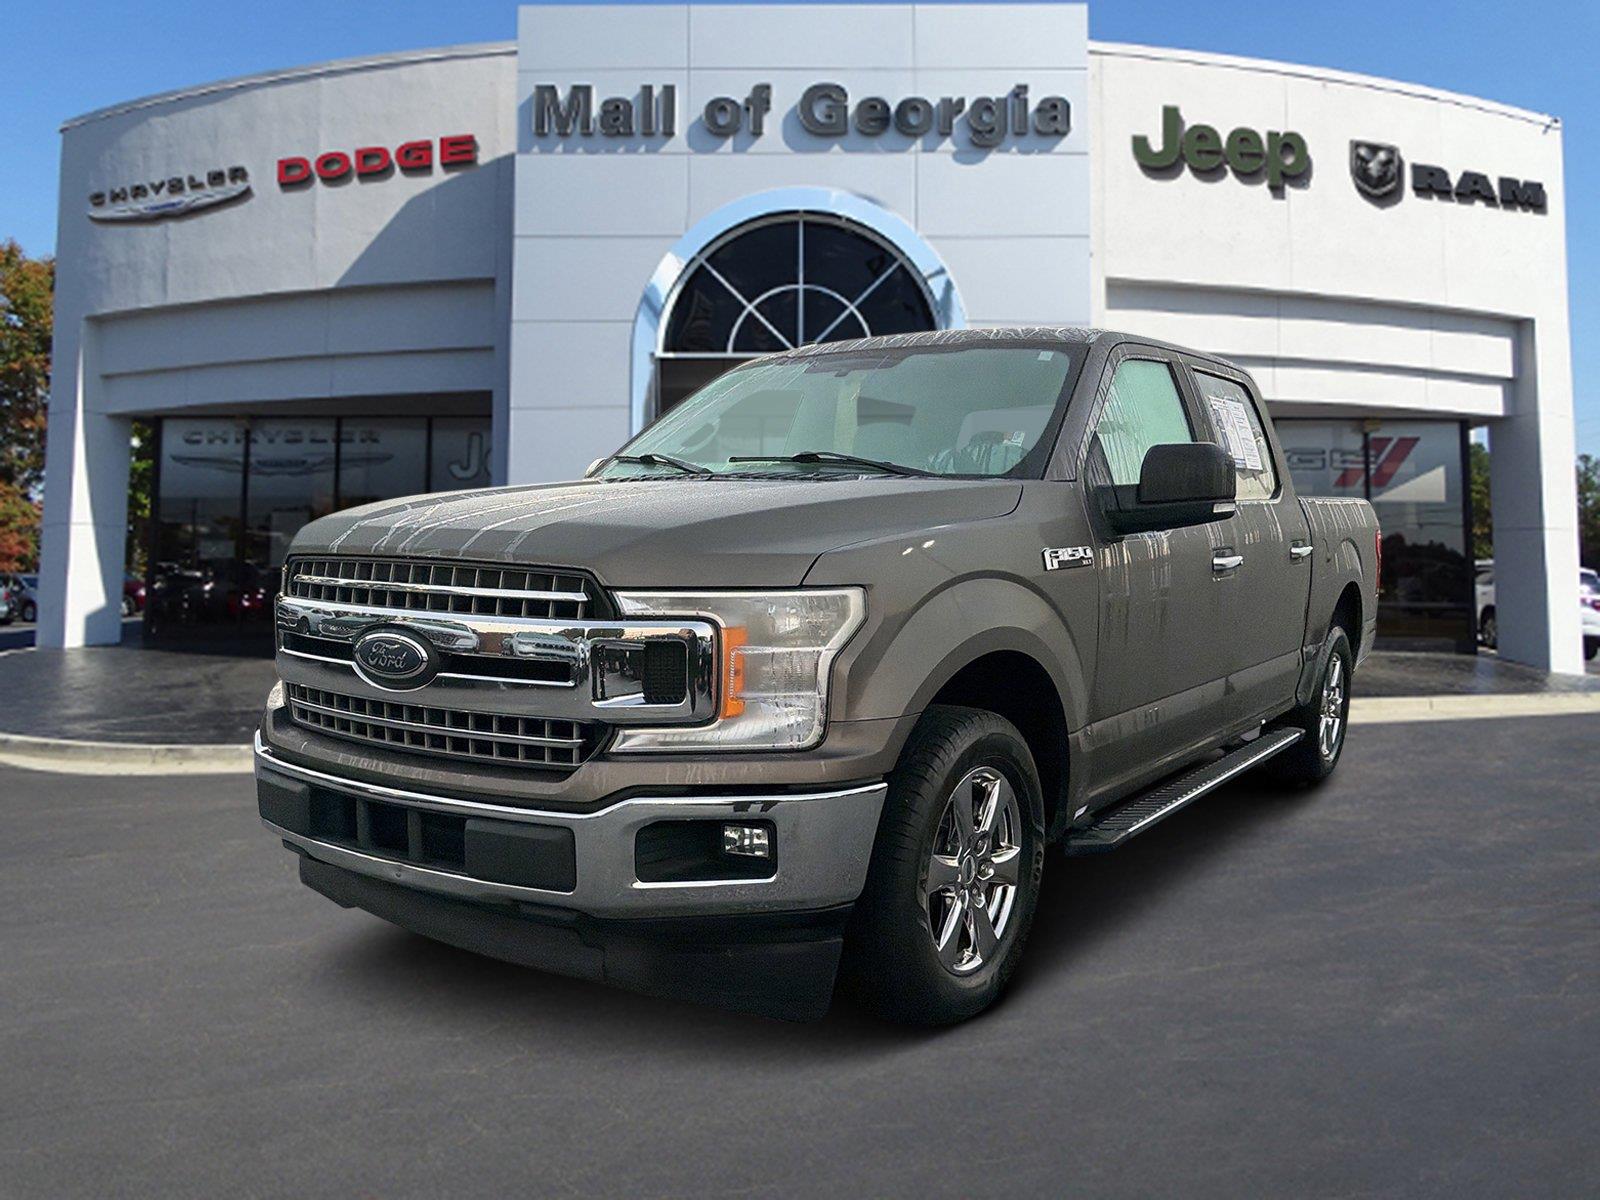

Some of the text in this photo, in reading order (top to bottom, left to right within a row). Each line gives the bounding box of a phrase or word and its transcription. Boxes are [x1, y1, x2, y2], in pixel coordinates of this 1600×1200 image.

[532, 84, 1072, 147] Mall of Georgia
[277, 134, 478, 190] DODGE
[1131, 105, 1310, 193] Jeep
[89, 166, 249, 207] CHRYSLER
[1411, 163, 1547, 213] RAM
[367, 641, 409, 669] Ford
